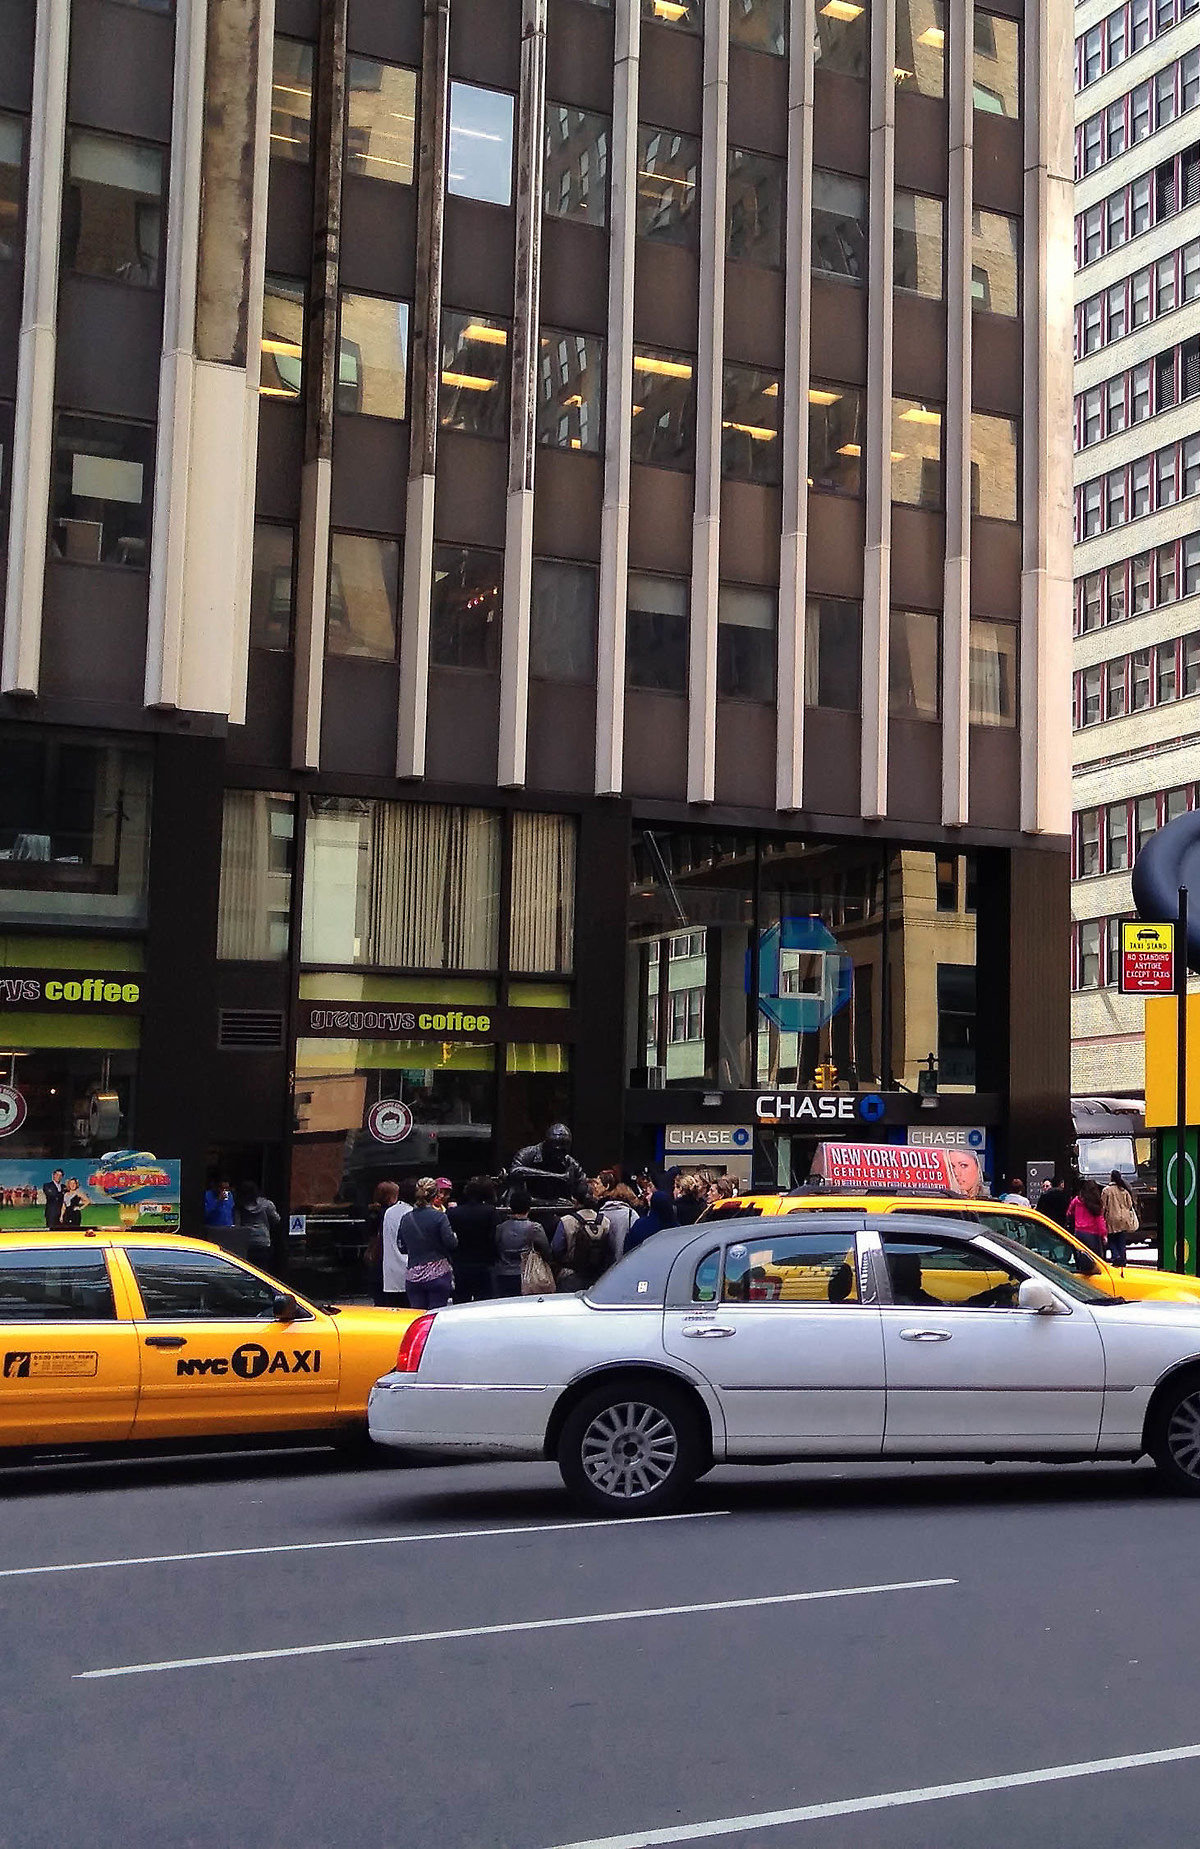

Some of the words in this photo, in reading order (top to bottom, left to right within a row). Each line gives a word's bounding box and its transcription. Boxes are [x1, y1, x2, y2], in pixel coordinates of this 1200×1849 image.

[1127, 953, 1136, 961] NO
[1138, 953, 1170, 961] STANDING
[45, 978, 140, 1003] coffee
[310, 1009, 416, 1031] gregorys
[418, 1011, 491, 1032] coffee
[755, 1095, 856, 1119] CHASE
[668, 1129, 731, 1145] CHASE
[910, 1130, 967, 1145] CHASE
[831, 1147, 861, 1166] NEW
[863, 1149, 898, 1167] YORK
[900, 1150, 940, 1170] DOLLS
[833, 1166, 911, 1180] GENTLEMEN'S
[916, 1169, 944, 1181] CLUB
[291, 1216, 304, 1231] A
[176, 1358, 229, 1376] NYC
[232, 1343, 321, 1378] TAXI
